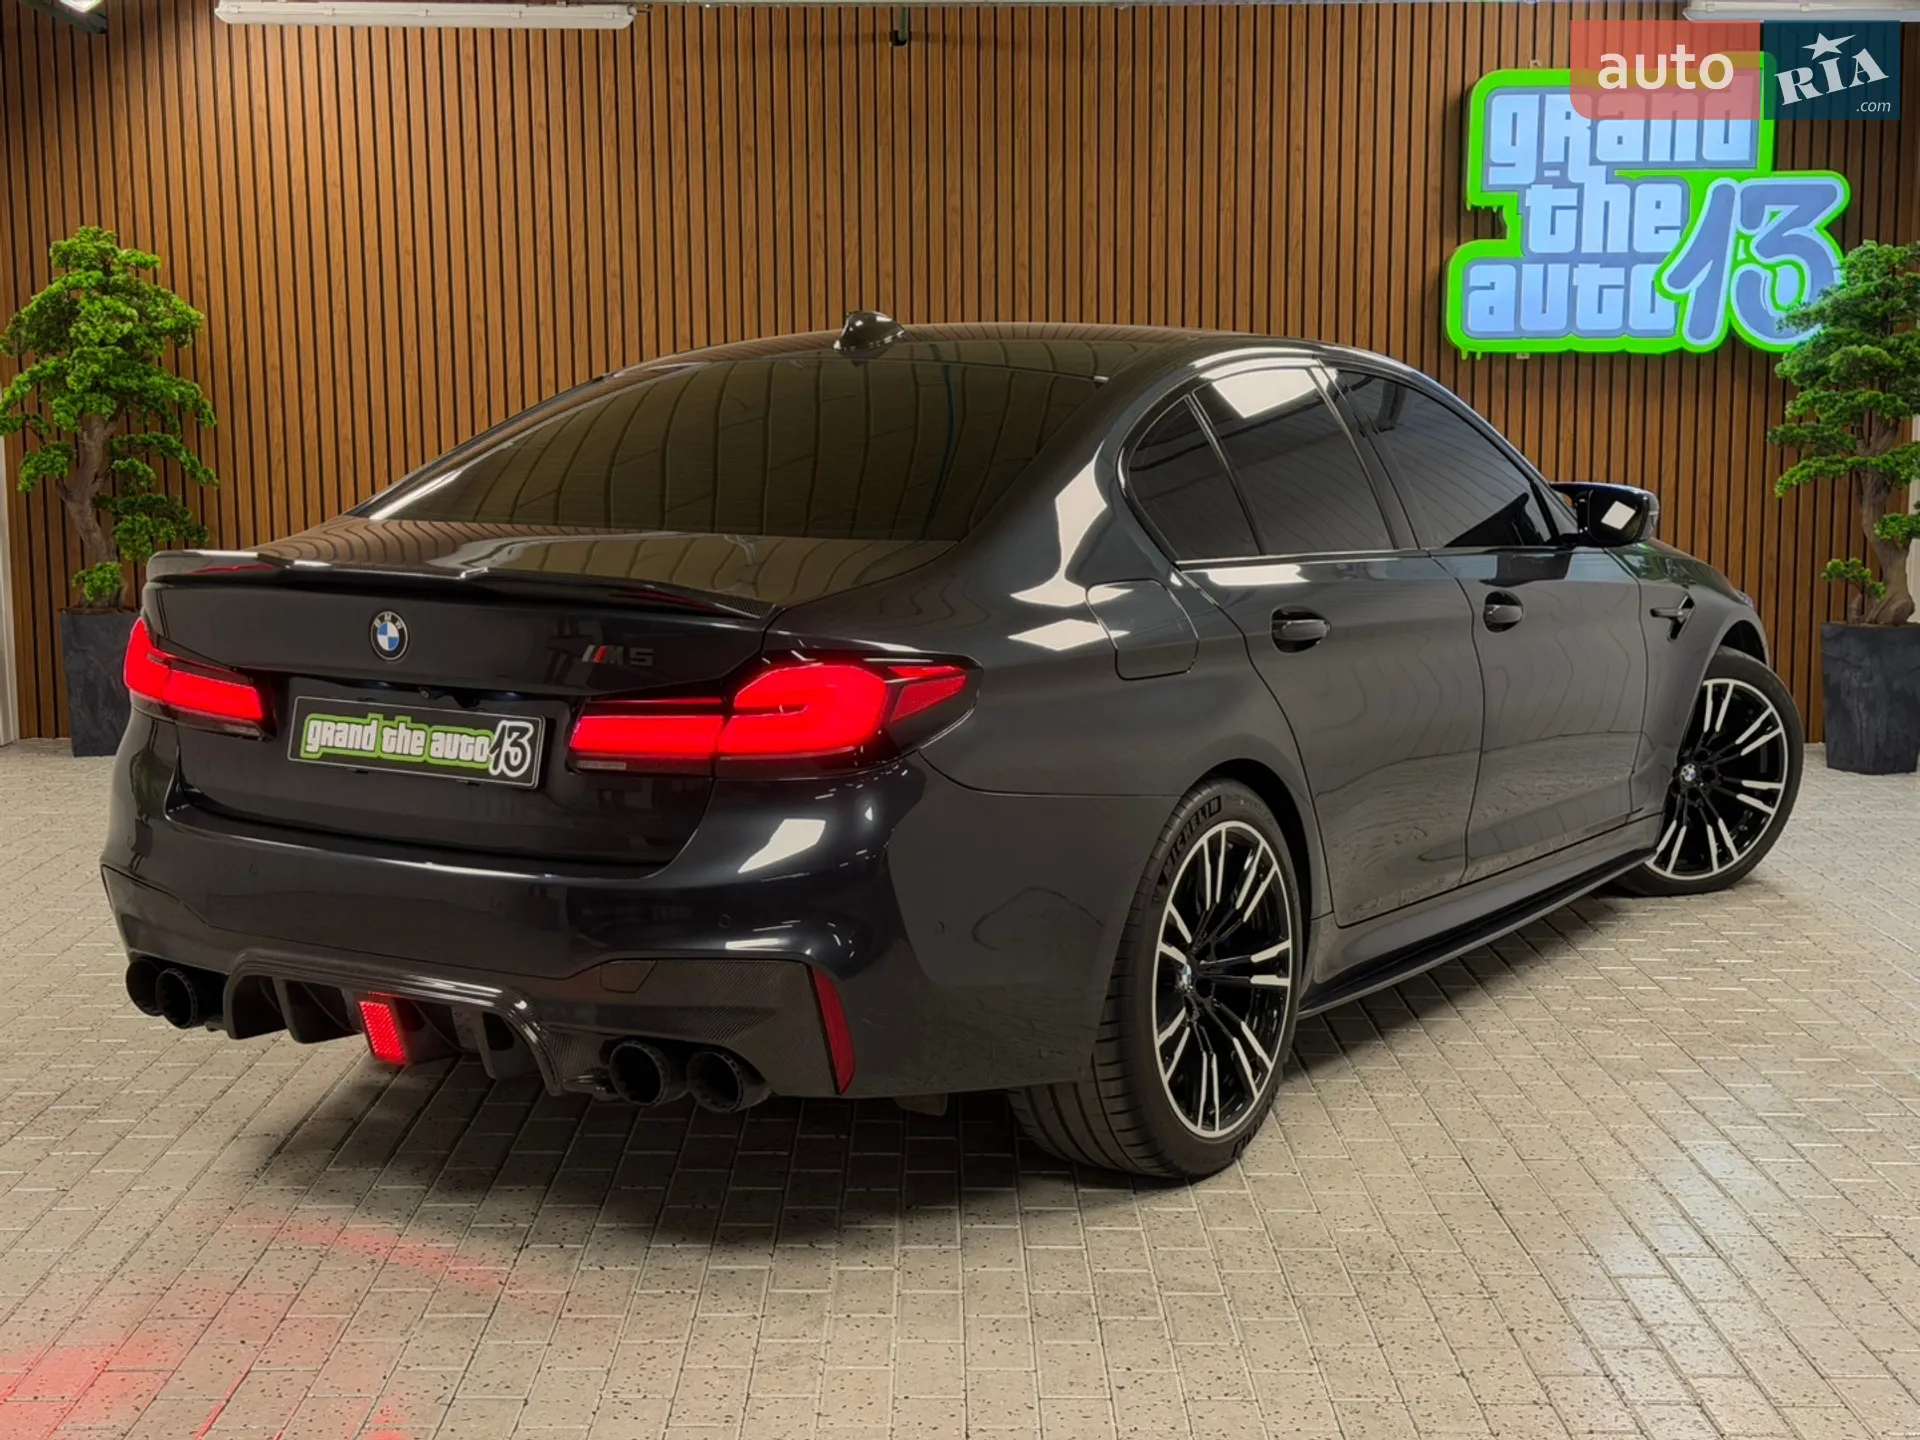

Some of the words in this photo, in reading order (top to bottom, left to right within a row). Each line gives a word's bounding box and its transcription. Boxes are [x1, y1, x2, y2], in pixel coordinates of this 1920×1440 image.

[1525, 164, 1684, 254] the
[1466, 262, 1677, 333] auto
[1662, 177, 1844, 346] 13
[374, 612, 404, 630] BMW
[594, 644, 654, 667] M5
[382, 721, 427, 756] the
[429, 731, 491, 763] auto
[488, 719, 534, 778] 13
[1162, 794, 1223, 878] MICHELIN
